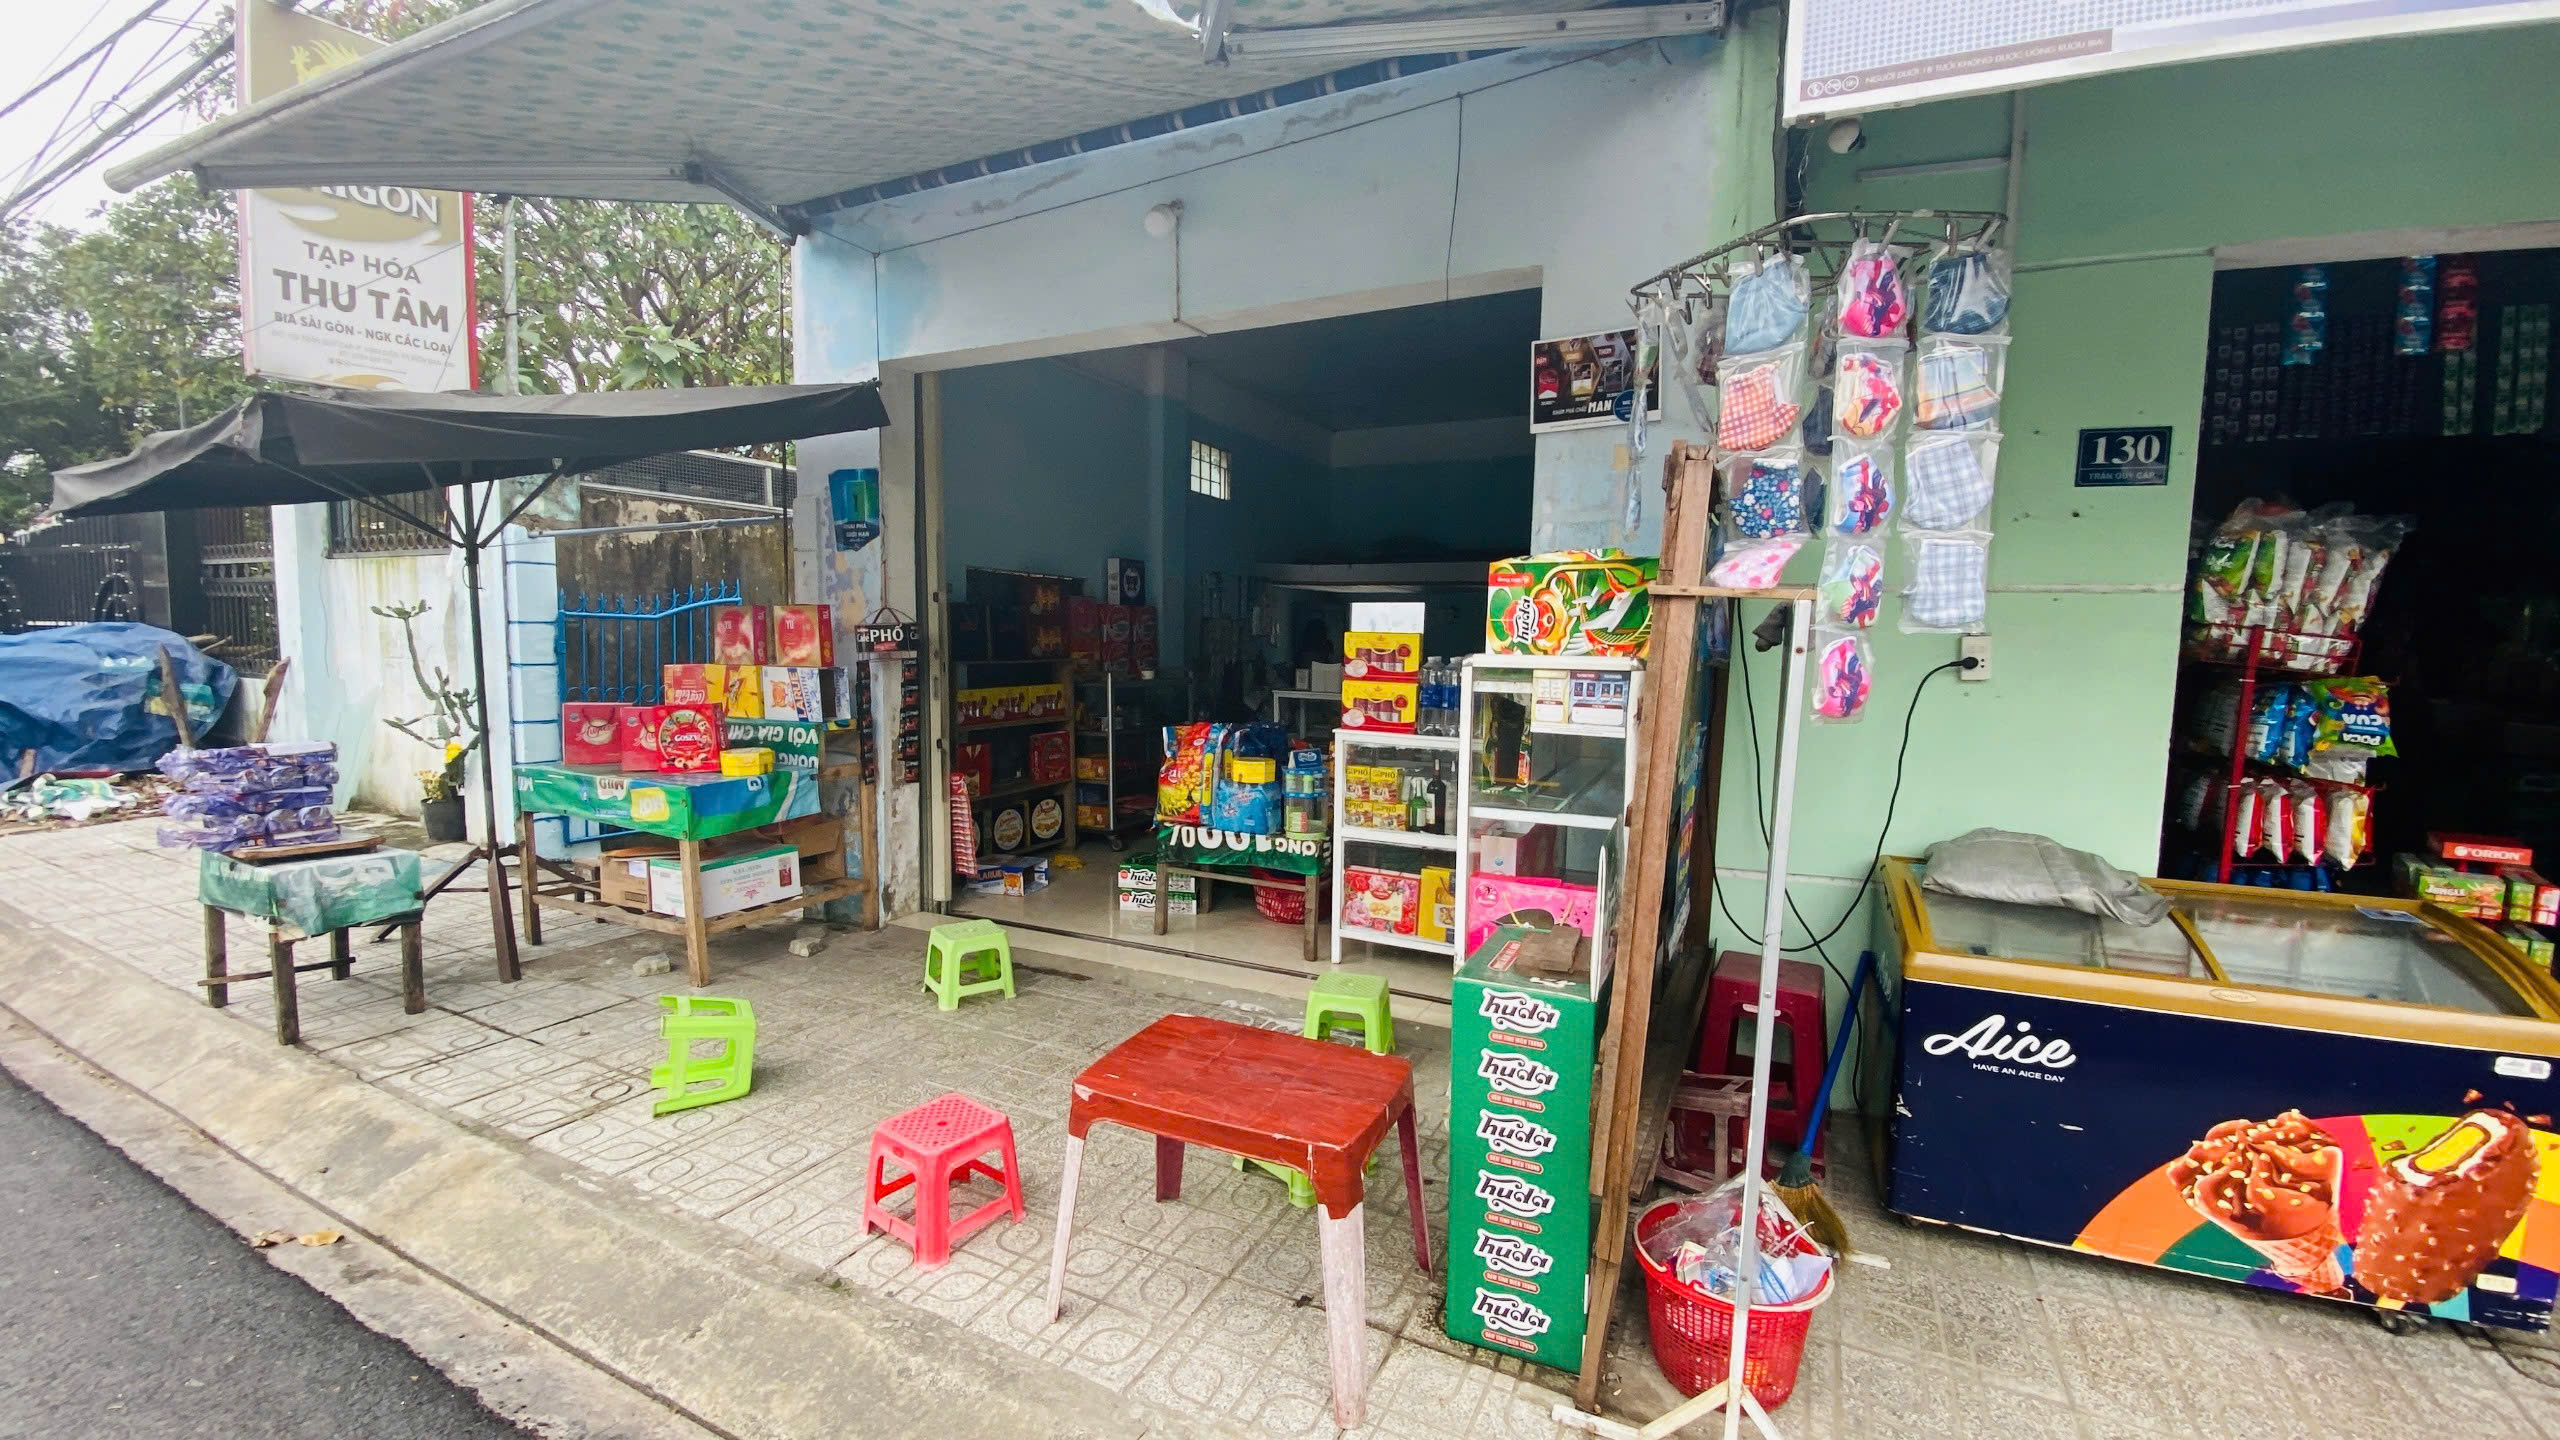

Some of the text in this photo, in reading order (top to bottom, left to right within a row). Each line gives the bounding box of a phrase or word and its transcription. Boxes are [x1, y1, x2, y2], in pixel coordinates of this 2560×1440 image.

[302, 240, 421, 284] TẠP HÓA
[272, 268, 448, 333] THU TÂM
[275, 311, 297, 324] BIA
[301, 315, 322, 329] SÀI
[324, 319, 354, 335] GÒN
[365, 328, 392, 342] NGK
[395, 333, 421, 348] CÁC
[423, 339, 452, 357] LOẠI
[2089, 434, 2161, 465] 130
[870, 623, 904, 643] PHỐ
[1515, 598, 1538, 642] huda
[788, 672, 808, 718] LARUE
[788, 727, 819, 747] VỚI
[2342, 713, 2383, 726] CUA
[2343, 732, 2381, 746] POCA
[2470, 848, 2520, 861] ORION
[1132, 892, 1157, 908] hud
[1484, 992, 1555, 1029] huda
[1923, 1014, 2077, 1069] Aice
[1482, 1052, 1554, 1091] huda
[1972, 1063, 2065, 1083] HAVE AN AICE DAY
[1480, 1112, 1552, 1152] huda
[1479, 1172, 1550, 1213] huda
[1478, 1232, 1548, 1272] huda
[1476, 1292, 1546, 1332] huda
